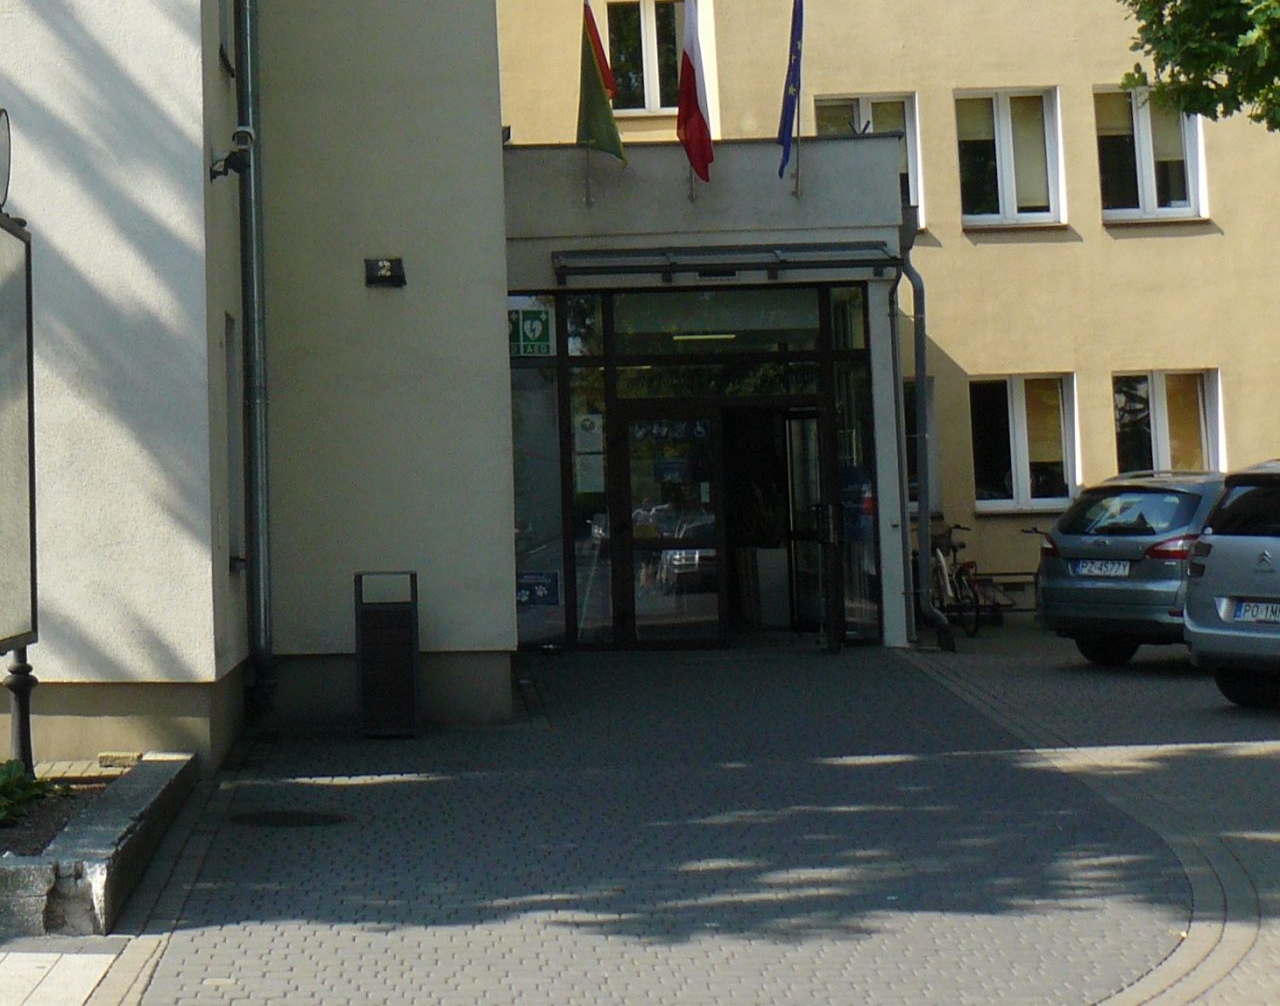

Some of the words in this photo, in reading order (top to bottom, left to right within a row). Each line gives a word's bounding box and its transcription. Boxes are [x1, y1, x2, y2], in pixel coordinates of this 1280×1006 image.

[377, 260, 391, 277] 2
[526, 345, 548, 354] AED
[1243, 604, 1259, 619] PO
